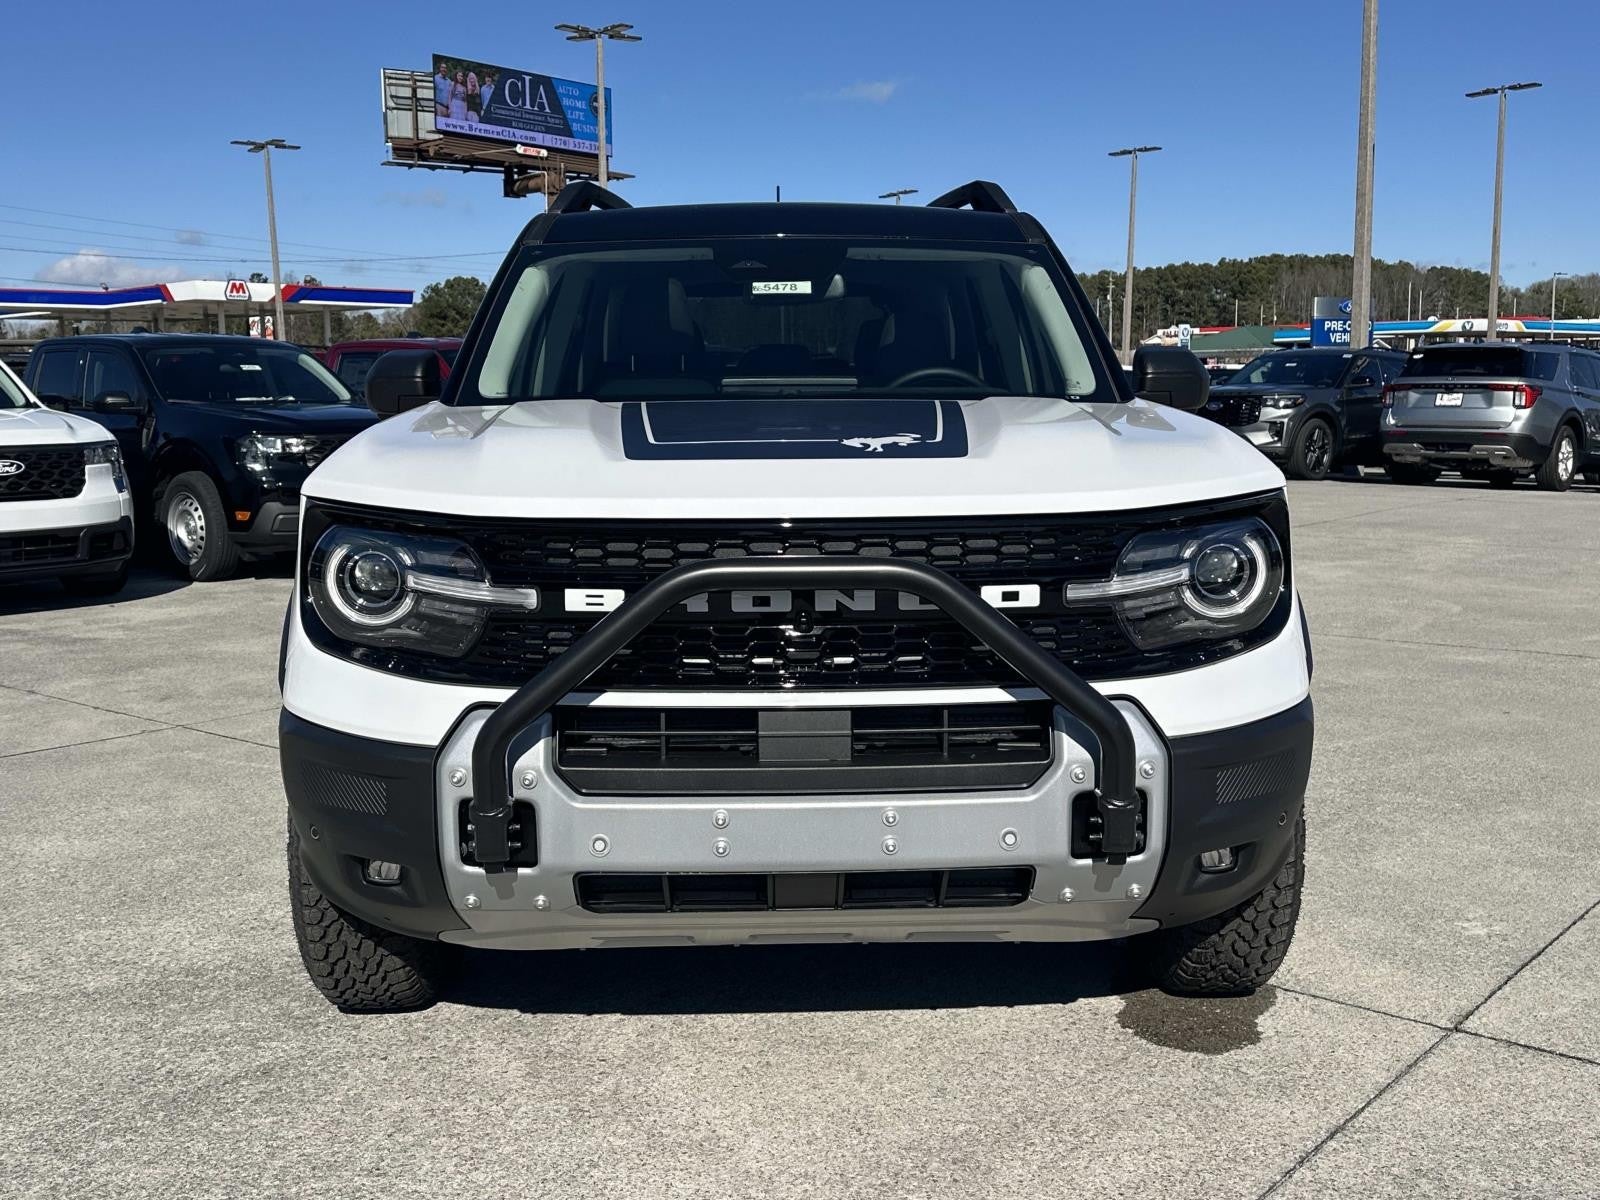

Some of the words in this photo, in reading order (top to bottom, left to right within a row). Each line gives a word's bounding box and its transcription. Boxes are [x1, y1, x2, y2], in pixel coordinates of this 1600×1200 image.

[504, 74, 551, 113] CIA
[558, 85, 579, 96] AUTO
[562, 97, 587, 109] HOME
[567, 110, 585, 120] LIFE
[444, 121, 537, 142] www.BremenCIA.com
[1329, 332, 1350, 343] VEHI
